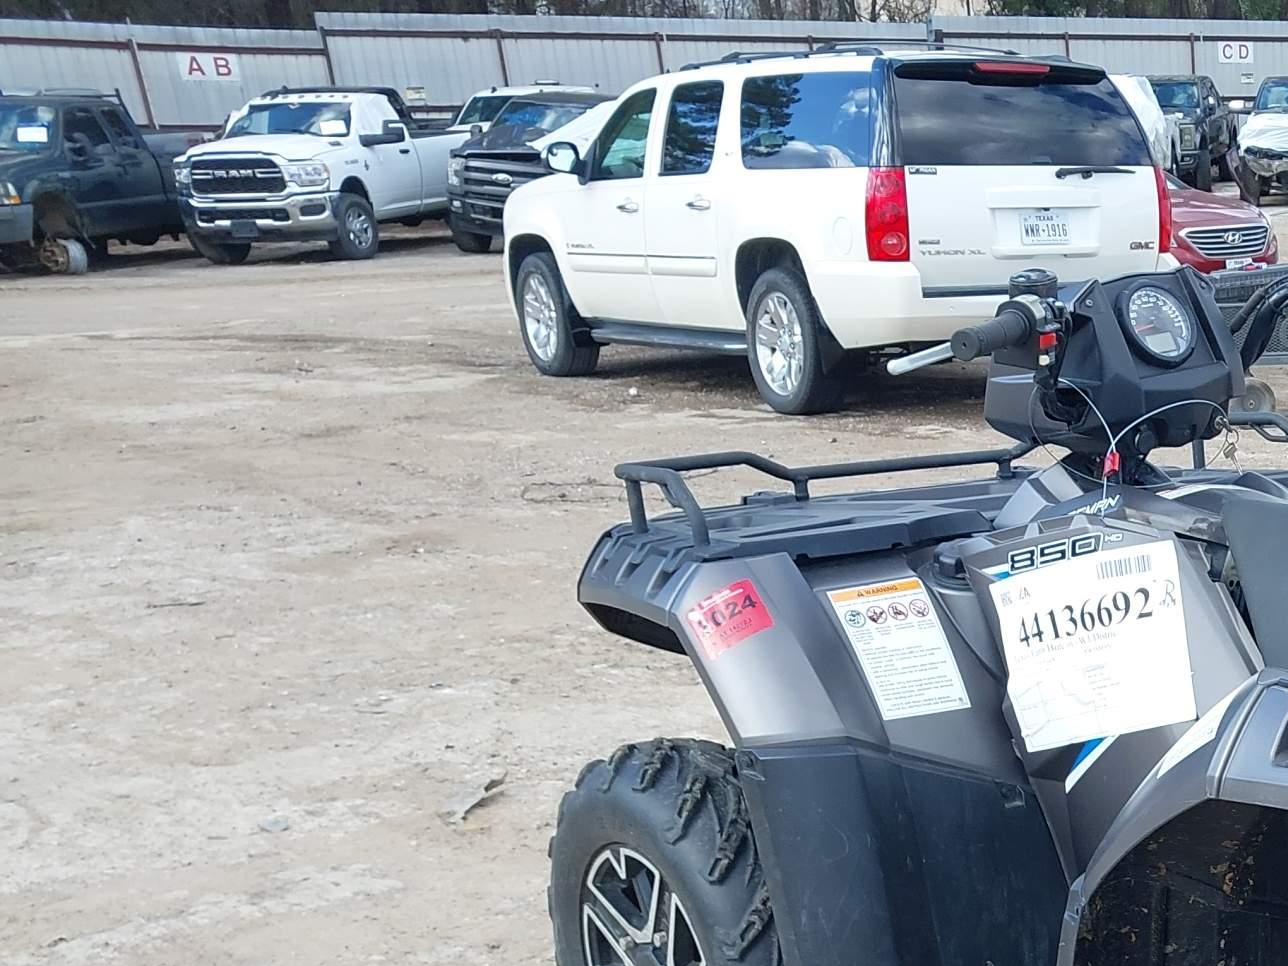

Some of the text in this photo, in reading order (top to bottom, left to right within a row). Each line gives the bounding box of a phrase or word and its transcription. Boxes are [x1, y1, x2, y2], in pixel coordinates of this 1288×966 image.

[1222, 43, 1249, 59] C D
[188, 55, 232, 76] A B
[213, 169, 255, 179] RAM
[1129, 241, 1155, 250] GMC
[1008, 532, 1124, 574] 850 HD
[1018, 586, 1154, 648] 44136692
